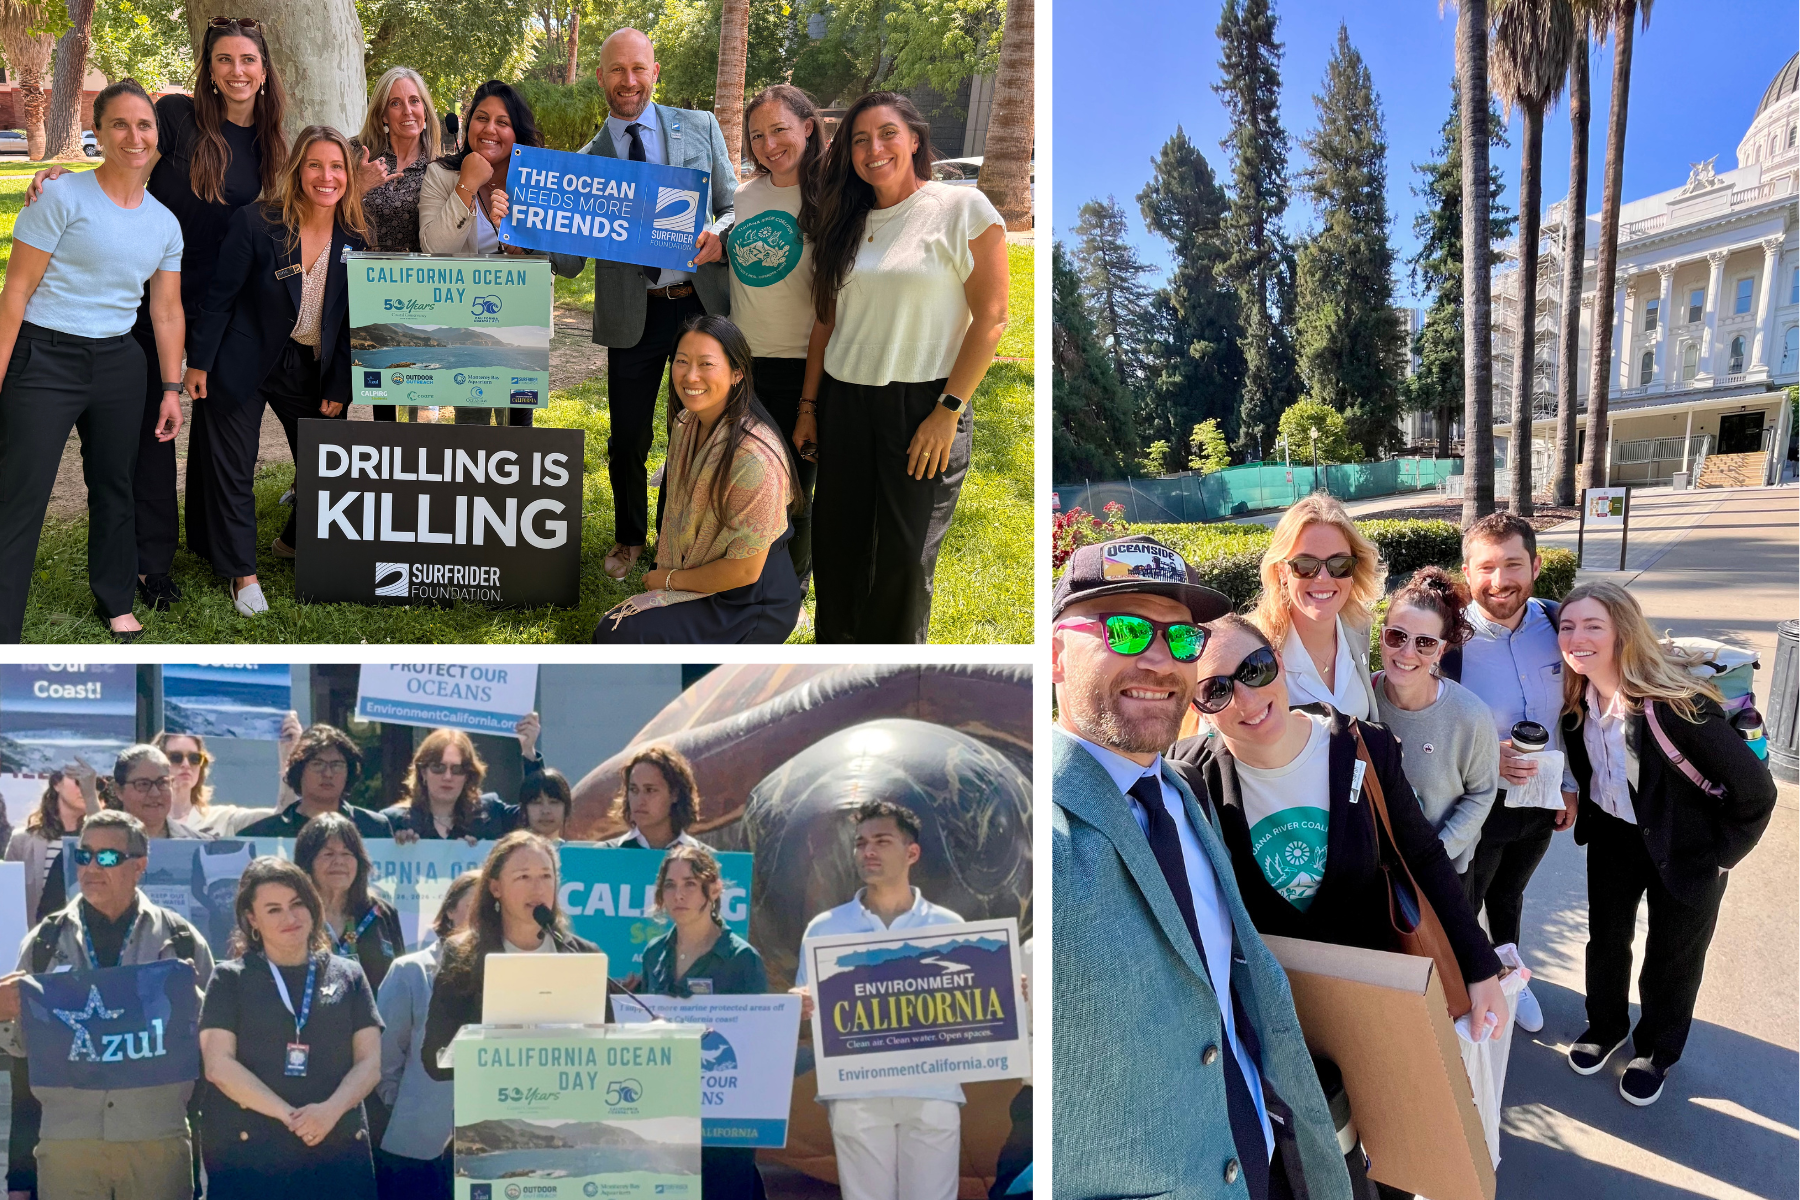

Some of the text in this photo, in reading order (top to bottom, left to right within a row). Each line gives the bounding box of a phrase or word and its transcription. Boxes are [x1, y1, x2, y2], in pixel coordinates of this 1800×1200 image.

[518, 167, 636, 199] THE OCEAN
[513, 187, 632, 218] NEEDS MORE
[511, 205, 630, 241] FRIENDS
[651, 229, 694, 246] SURFRIDER
[366, 267, 527, 286] CALIFORNIA OCEAN
[433, 288, 466, 304] DAY
[406, 299, 435, 314] Years
[318, 444, 570, 487] DRILLING IS
[317, 490, 568, 550] KILLING
[1108, 544, 1175, 561] OCEANSIDE
[412, 563, 500, 586] SURFRIDER
[470, 667, 508, 684] OUR
[34, 680, 102, 698] Coast!
[406, 678, 492, 702] OCEANS
[1272, 822, 1299, 836] RIVER
[1302, 821, 1328, 833] COALI
[854, 973, 974, 996] ENVIRONMENT
[680, 1004, 708, 1012] marine
[709, 1004, 748, 1013] protected
[772, 1004, 785, 1012] off
[833, 987, 1004, 1033] CALIFORNIA
[62, 1003, 166, 1062] Azul
[846, 1029, 994, 1050] Clean air. Clean water. Open spaces.
[478, 1046, 672, 1068] CALIFORNIA OCEAN
[838, 1056, 1009, 1082] EnvironmentCalifornia.org
[558, 1071, 598, 1091] DAY
[706, 1076, 738, 1088] OUR
[524, 1088, 560, 1105] Years
[701, 1128, 758, 1138] ALIFORNIA
[523, 1186, 557, 1194] OUTDOOR
